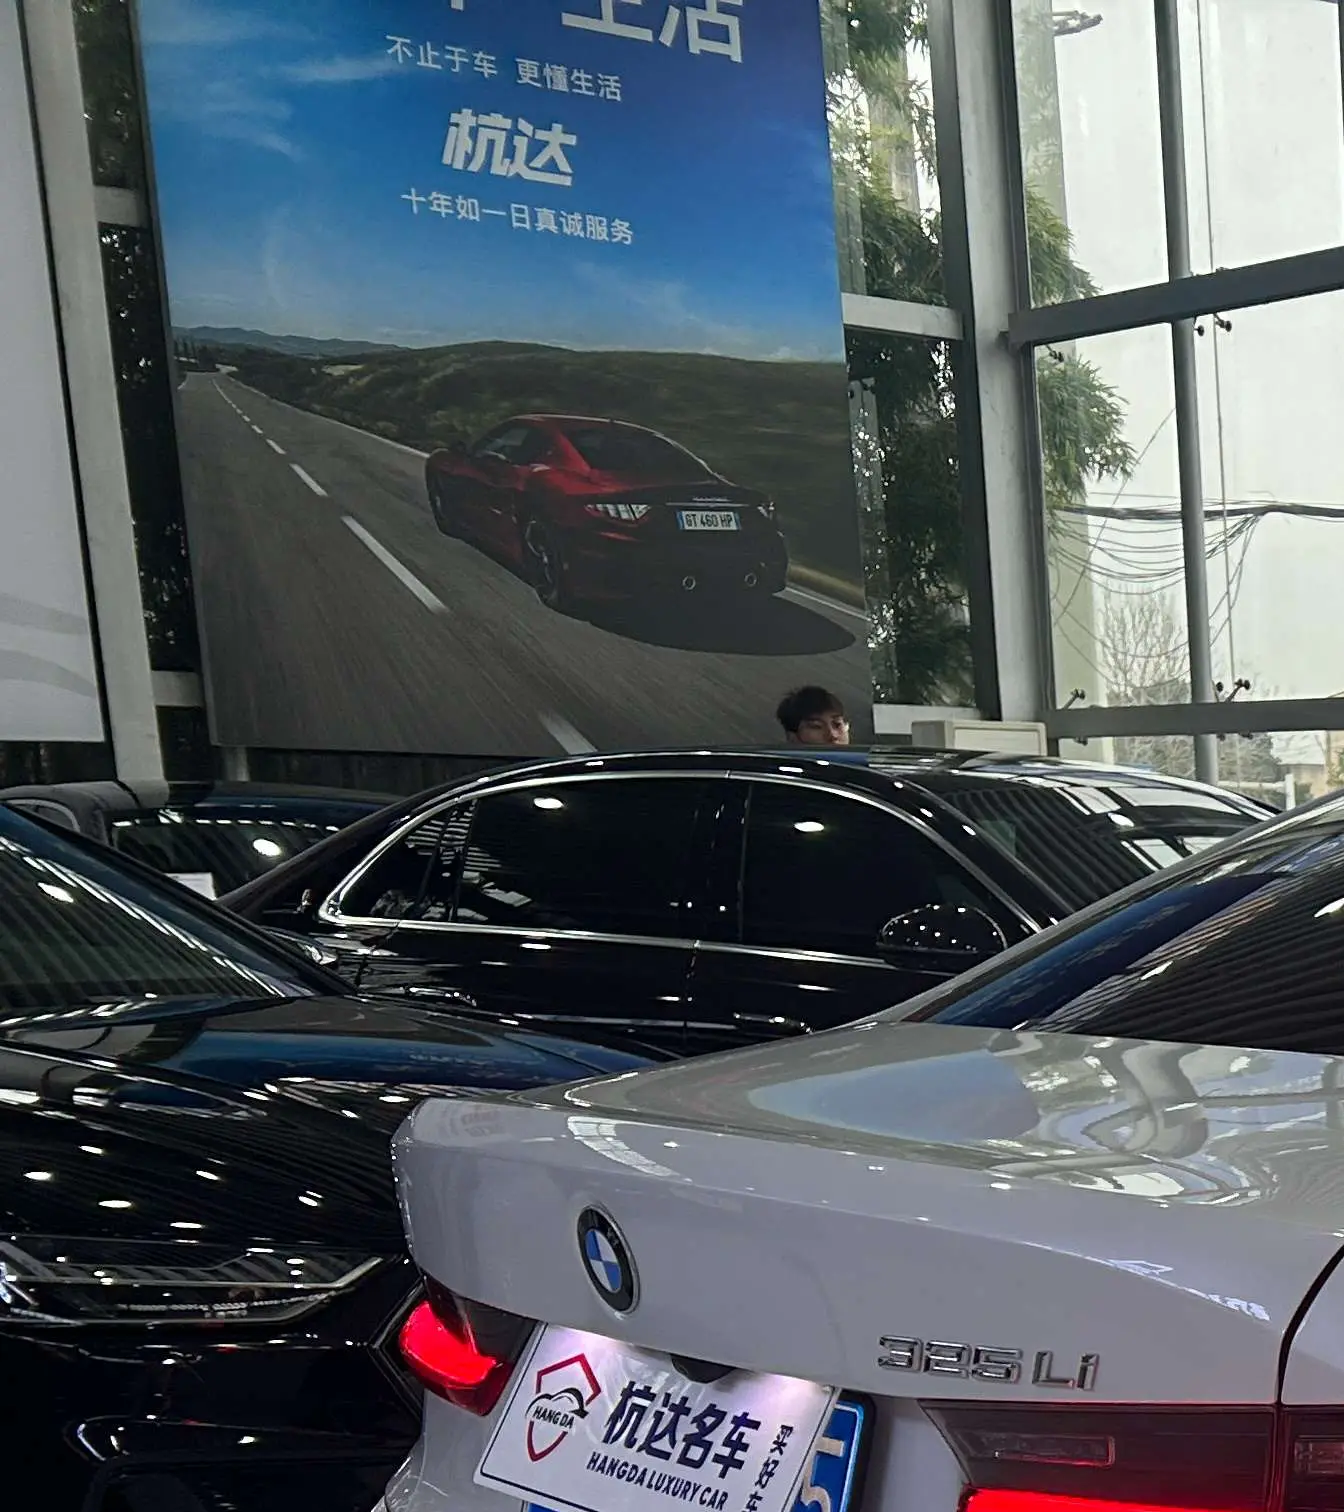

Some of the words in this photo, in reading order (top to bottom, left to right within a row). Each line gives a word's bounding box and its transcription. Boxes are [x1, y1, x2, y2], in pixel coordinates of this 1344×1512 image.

[385, 34, 499, 79] 不止于车
[515, 57, 623, 102] 更懂生活
[441, 107, 578, 187] 杭达
[400, 187, 634, 246] 十年如一日真诚服务
[602, 1381, 762, 1480] 杭达名车
[586, 1451, 648, 1487] HANGDA
[646, 1470, 702, 1502] LUXURY
[699, 1486, 729, 1511] CAR
